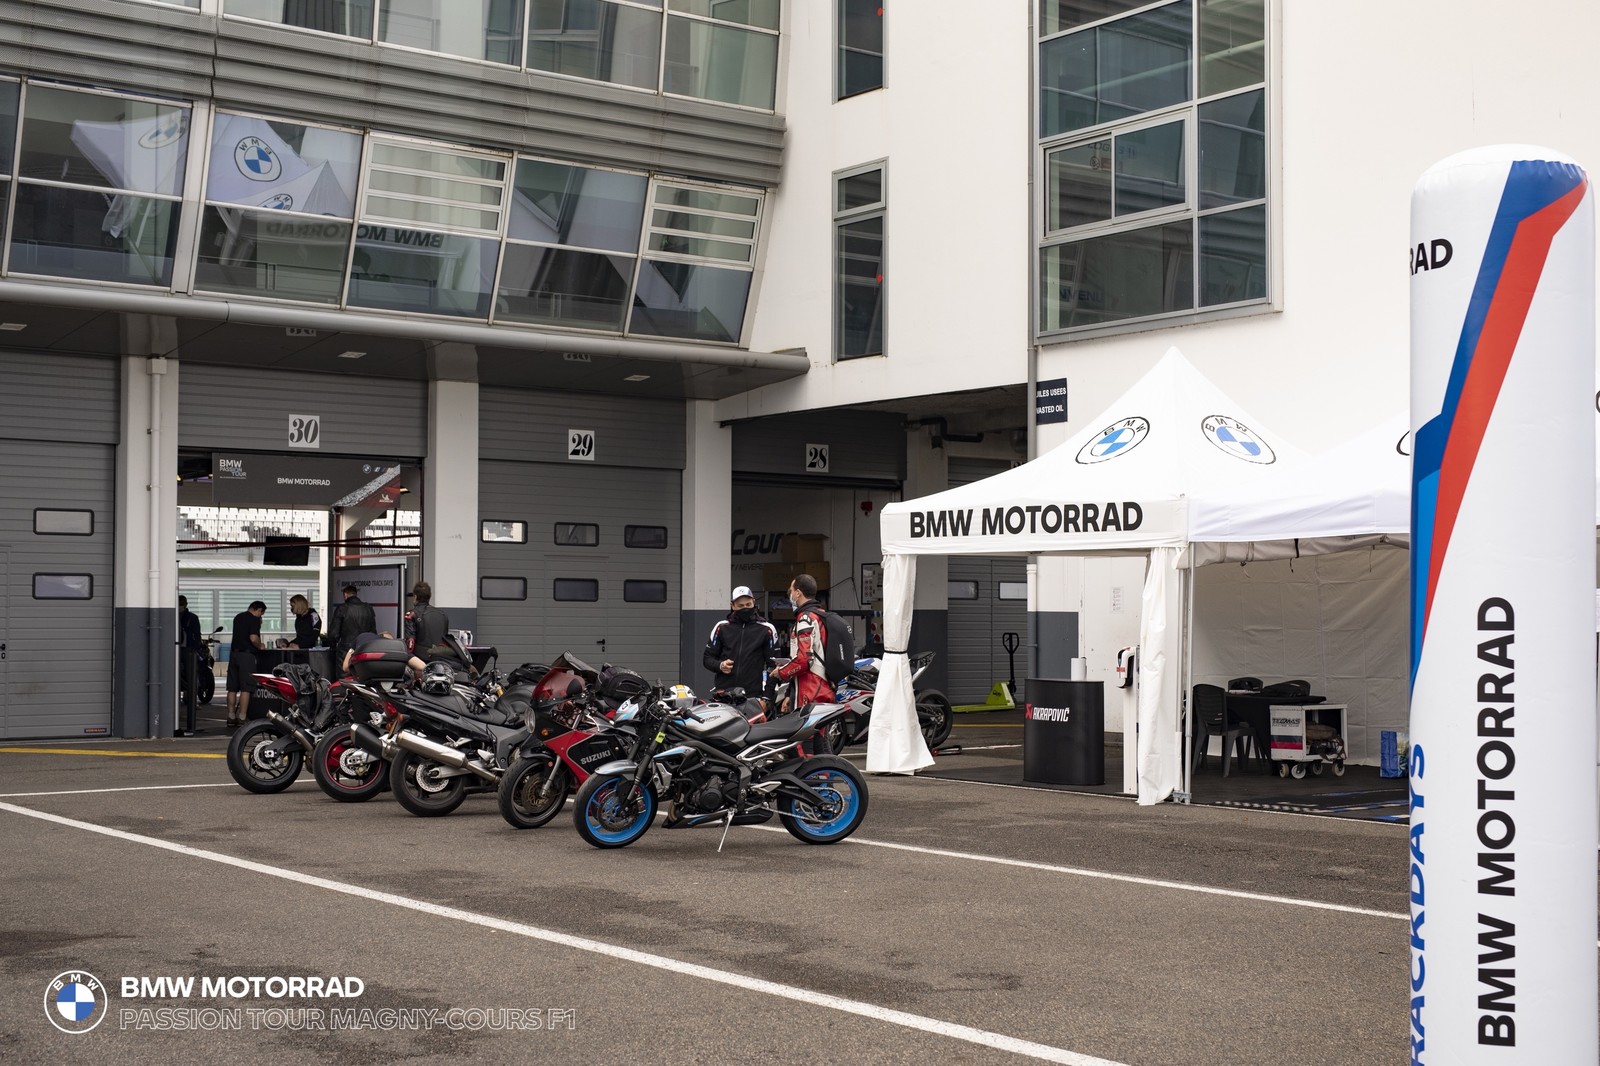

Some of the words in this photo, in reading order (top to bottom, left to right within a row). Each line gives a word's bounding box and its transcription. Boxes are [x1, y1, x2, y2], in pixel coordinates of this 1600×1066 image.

[1050, 387, 1066, 396] USEES
[290, 417, 318, 444] 30
[569, 433, 594, 457] 29
[219, 459, 242, 468] BMW
[807, 446, 828, 469] 28
[277, 477, 294, 485] BMW
[294, 478, 331, 487] MOTORRAD
[910, 508, 973, 539] BMW
[981, 501, 1144, 536] MOTORRAD
[731, 529, 798, 556] Cour
[580, 750, 612, 765] SUZUKI
[1477, 596, 1516, 897] MOTORRAD
[1477, 913, 1516, 1048] BMW
